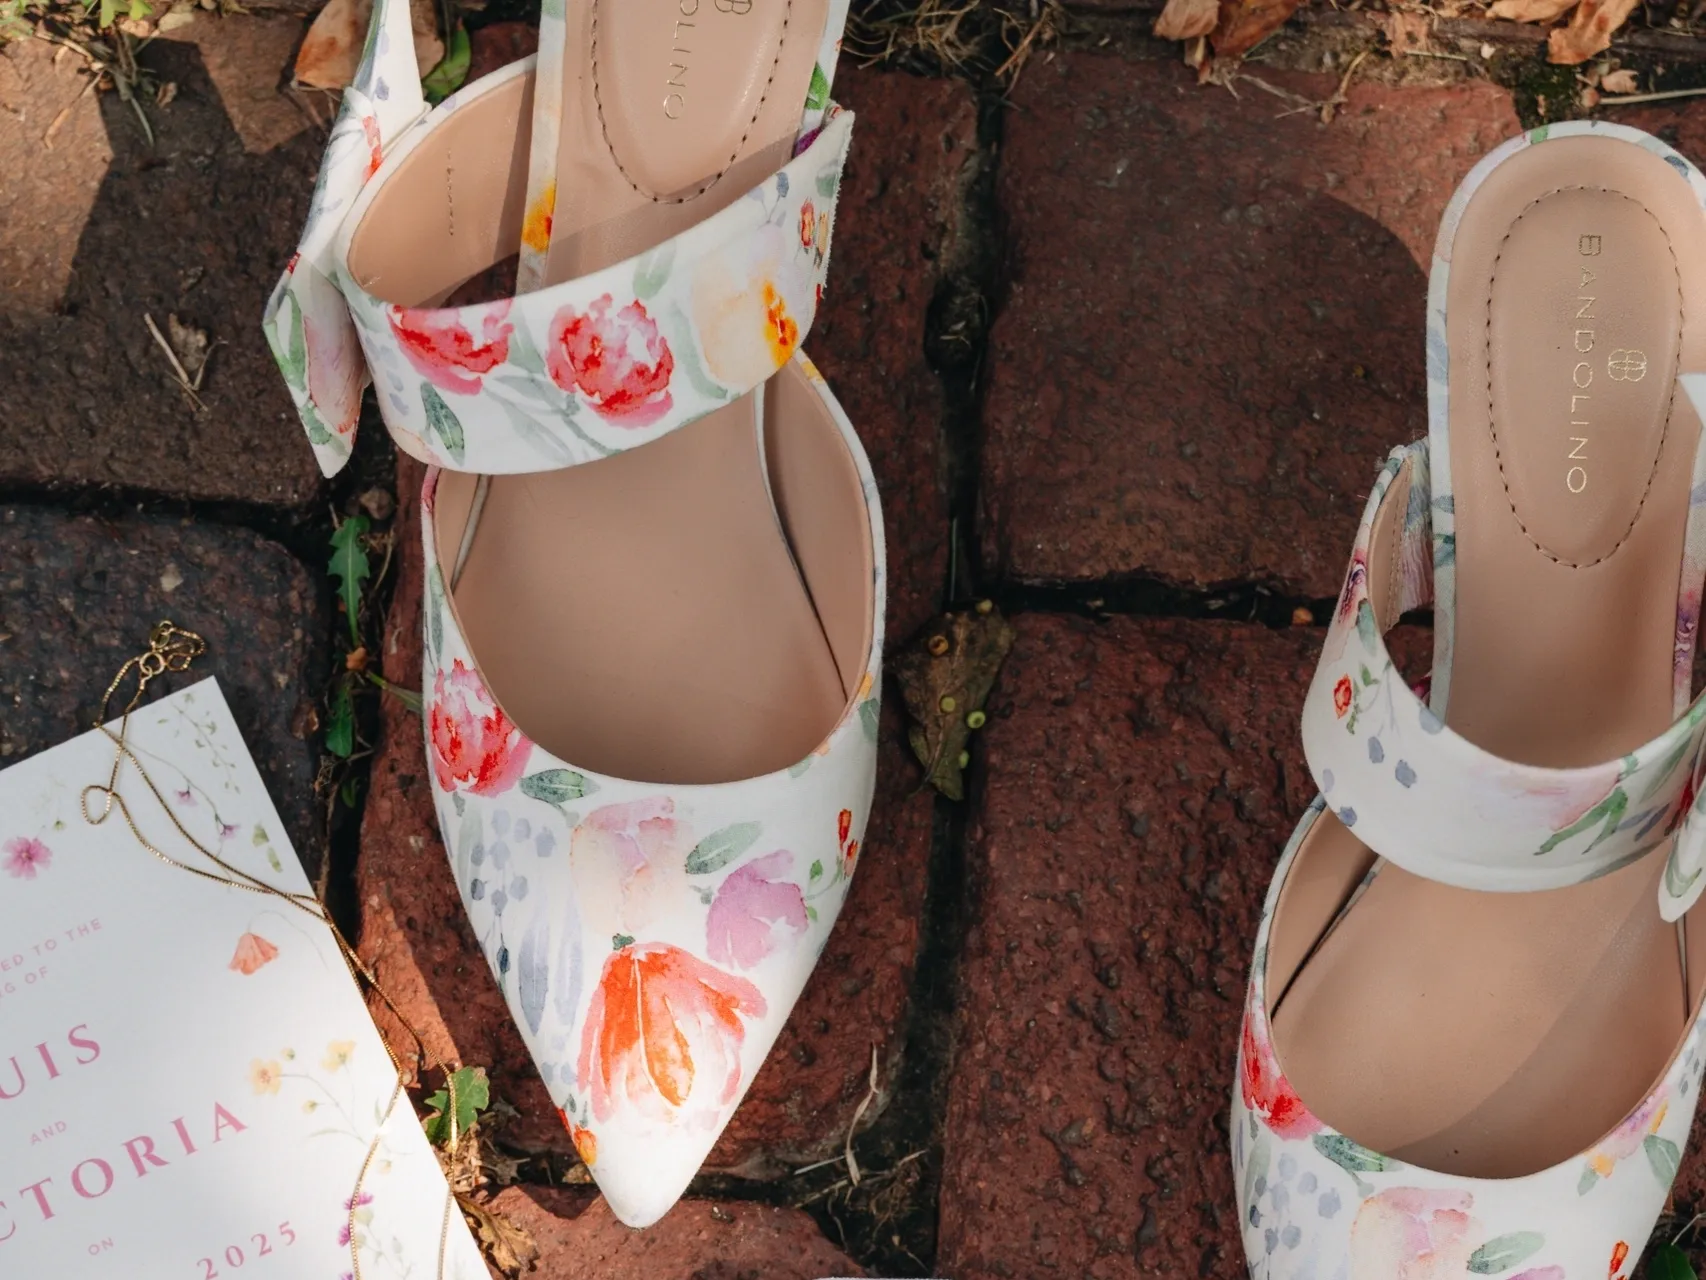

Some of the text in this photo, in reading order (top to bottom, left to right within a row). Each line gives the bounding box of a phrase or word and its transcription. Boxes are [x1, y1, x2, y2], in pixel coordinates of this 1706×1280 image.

[1566, 233, 1602, 493] BANDOLINO
[0, 917, 102, 972] ED TO THE
[24, 965, 48, 985] OF
[29, 1120, 67, 1146] AND
[87, 1237, 115, 1256] ON
